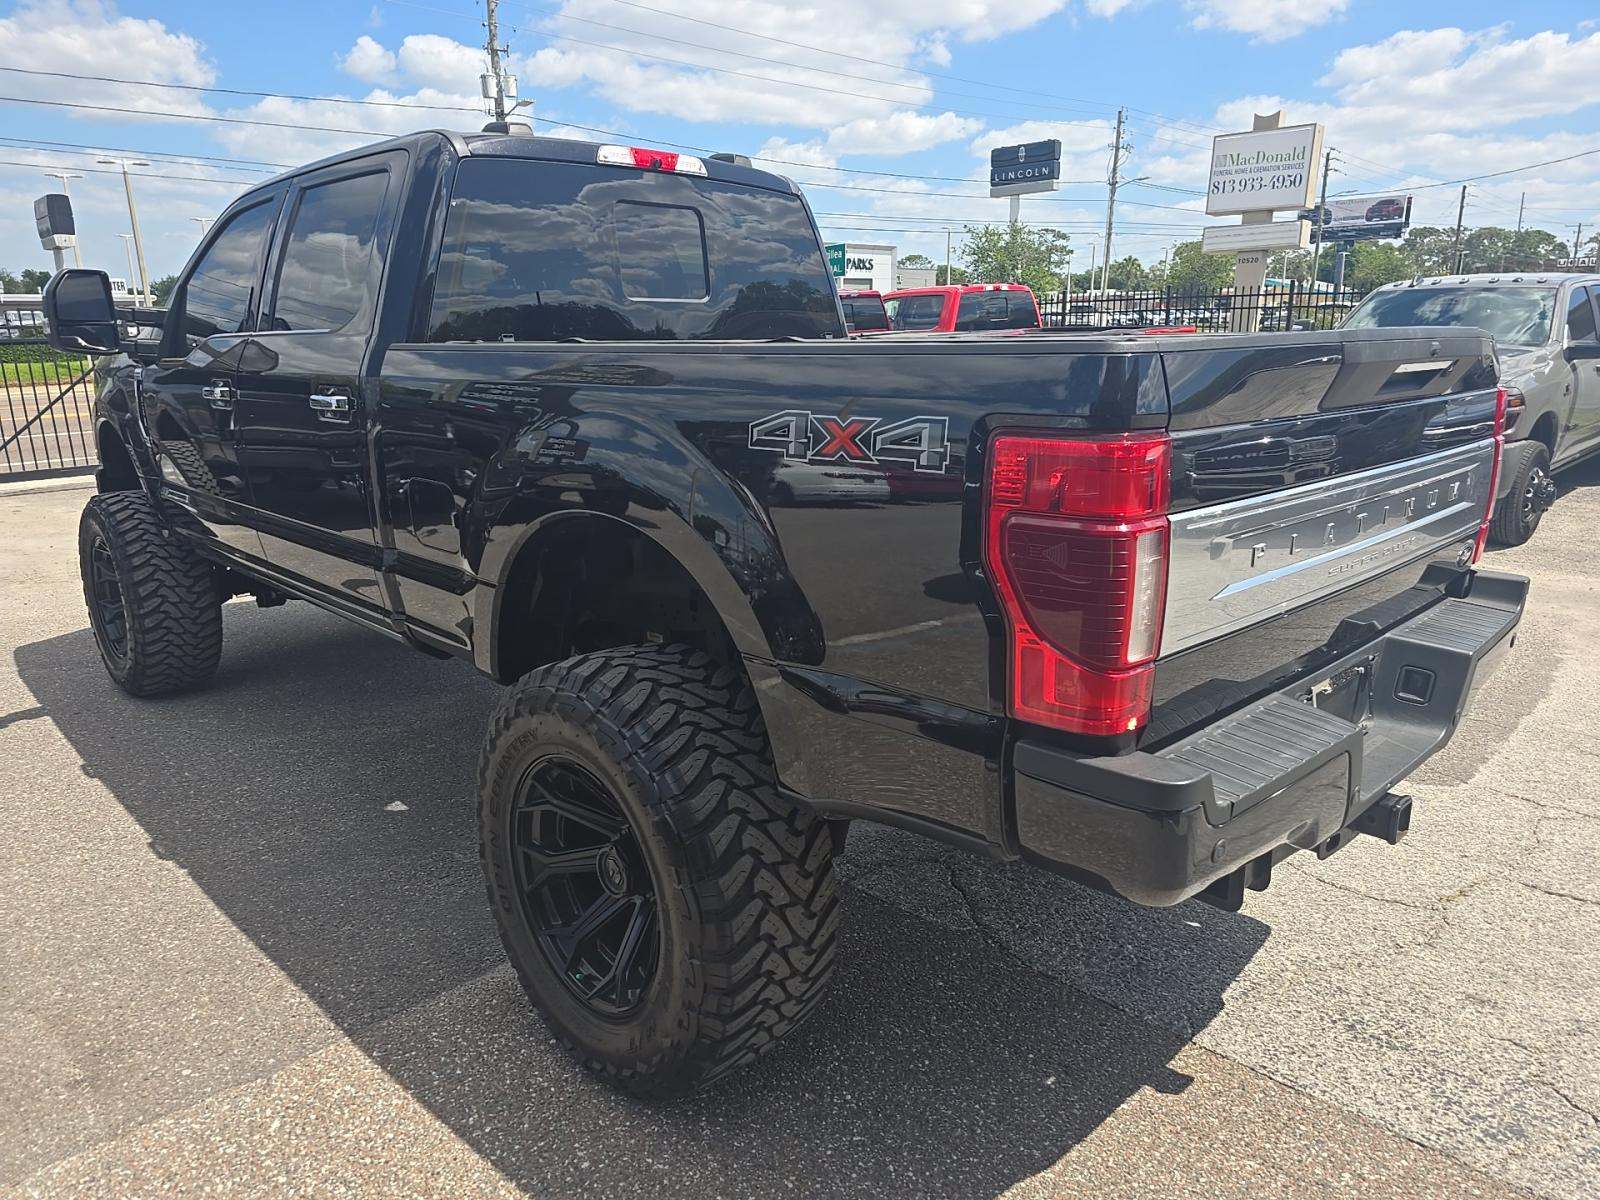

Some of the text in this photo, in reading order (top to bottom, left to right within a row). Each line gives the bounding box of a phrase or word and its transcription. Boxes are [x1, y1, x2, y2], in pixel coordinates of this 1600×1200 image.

[1228, 146, 1306, 167] MacDonald
[994, 167, 1049, 181] LINCOLN
[1213, 169, 1233, 177] FUNERAL
[1234, 167, 1249, 175] HOME
[1253, 164, 1280, 173] CREMATION
[1281, 162, 1305, 171] SERVICES
[1211, 172, 1303, 195] 813 933-4950
[846, 257, 874, 271] PARKS
[1238, 256, 1260, 264] 10520
[1250, 481, 1461, 568] PLATINUM
